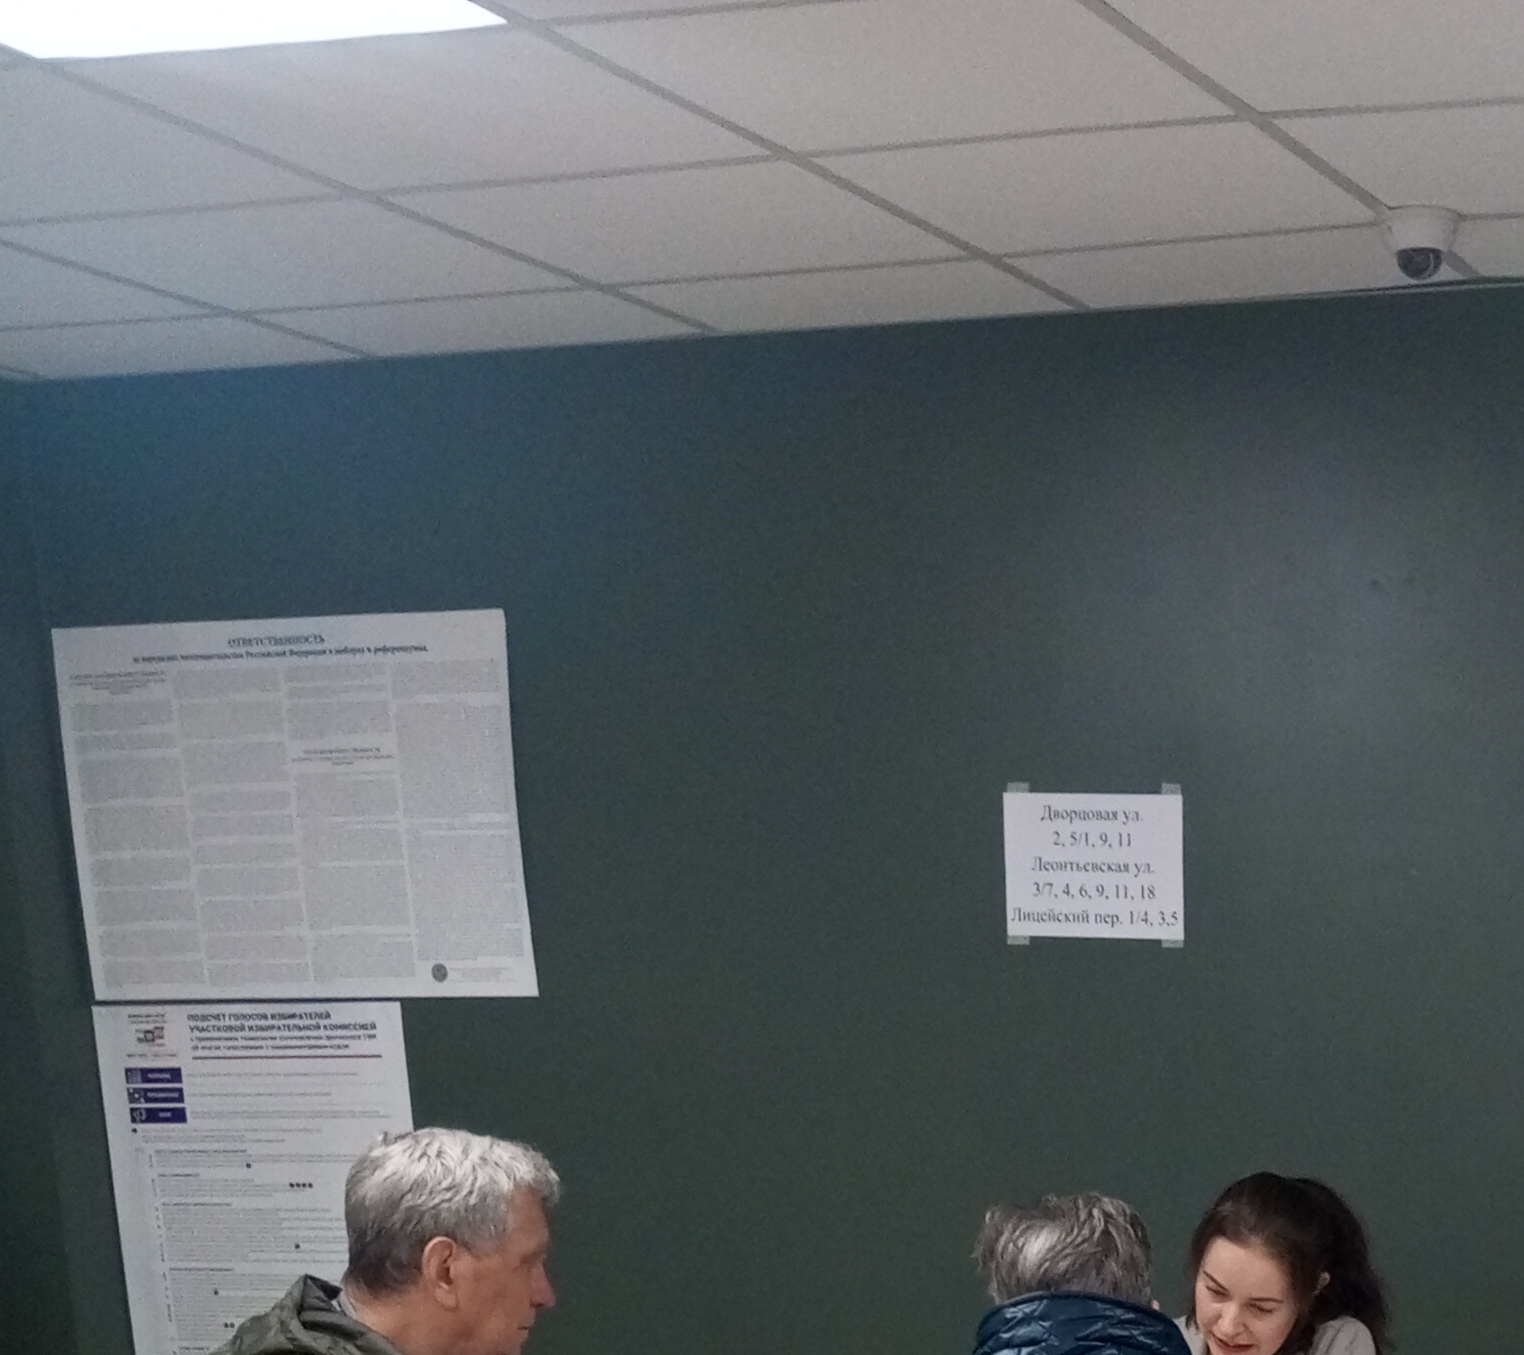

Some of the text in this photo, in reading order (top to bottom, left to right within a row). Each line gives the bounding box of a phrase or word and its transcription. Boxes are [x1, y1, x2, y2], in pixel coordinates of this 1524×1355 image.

[1041, 805, 1143, 825] Дворцовая ул.
[1052, 832, 1132, 848] 2, 5/1, 9, 11
[1032, 857, 1155, 877] Леонтьевская ул.
[1032, 882, 1156, 901] 3/7, 4, 6, 9, 11, 18
[1011, 908, 1090, 924] Лицейский
[1094, 913, 1122, 928] пер.
[1129, 911, 1153, 927] 1/4,
